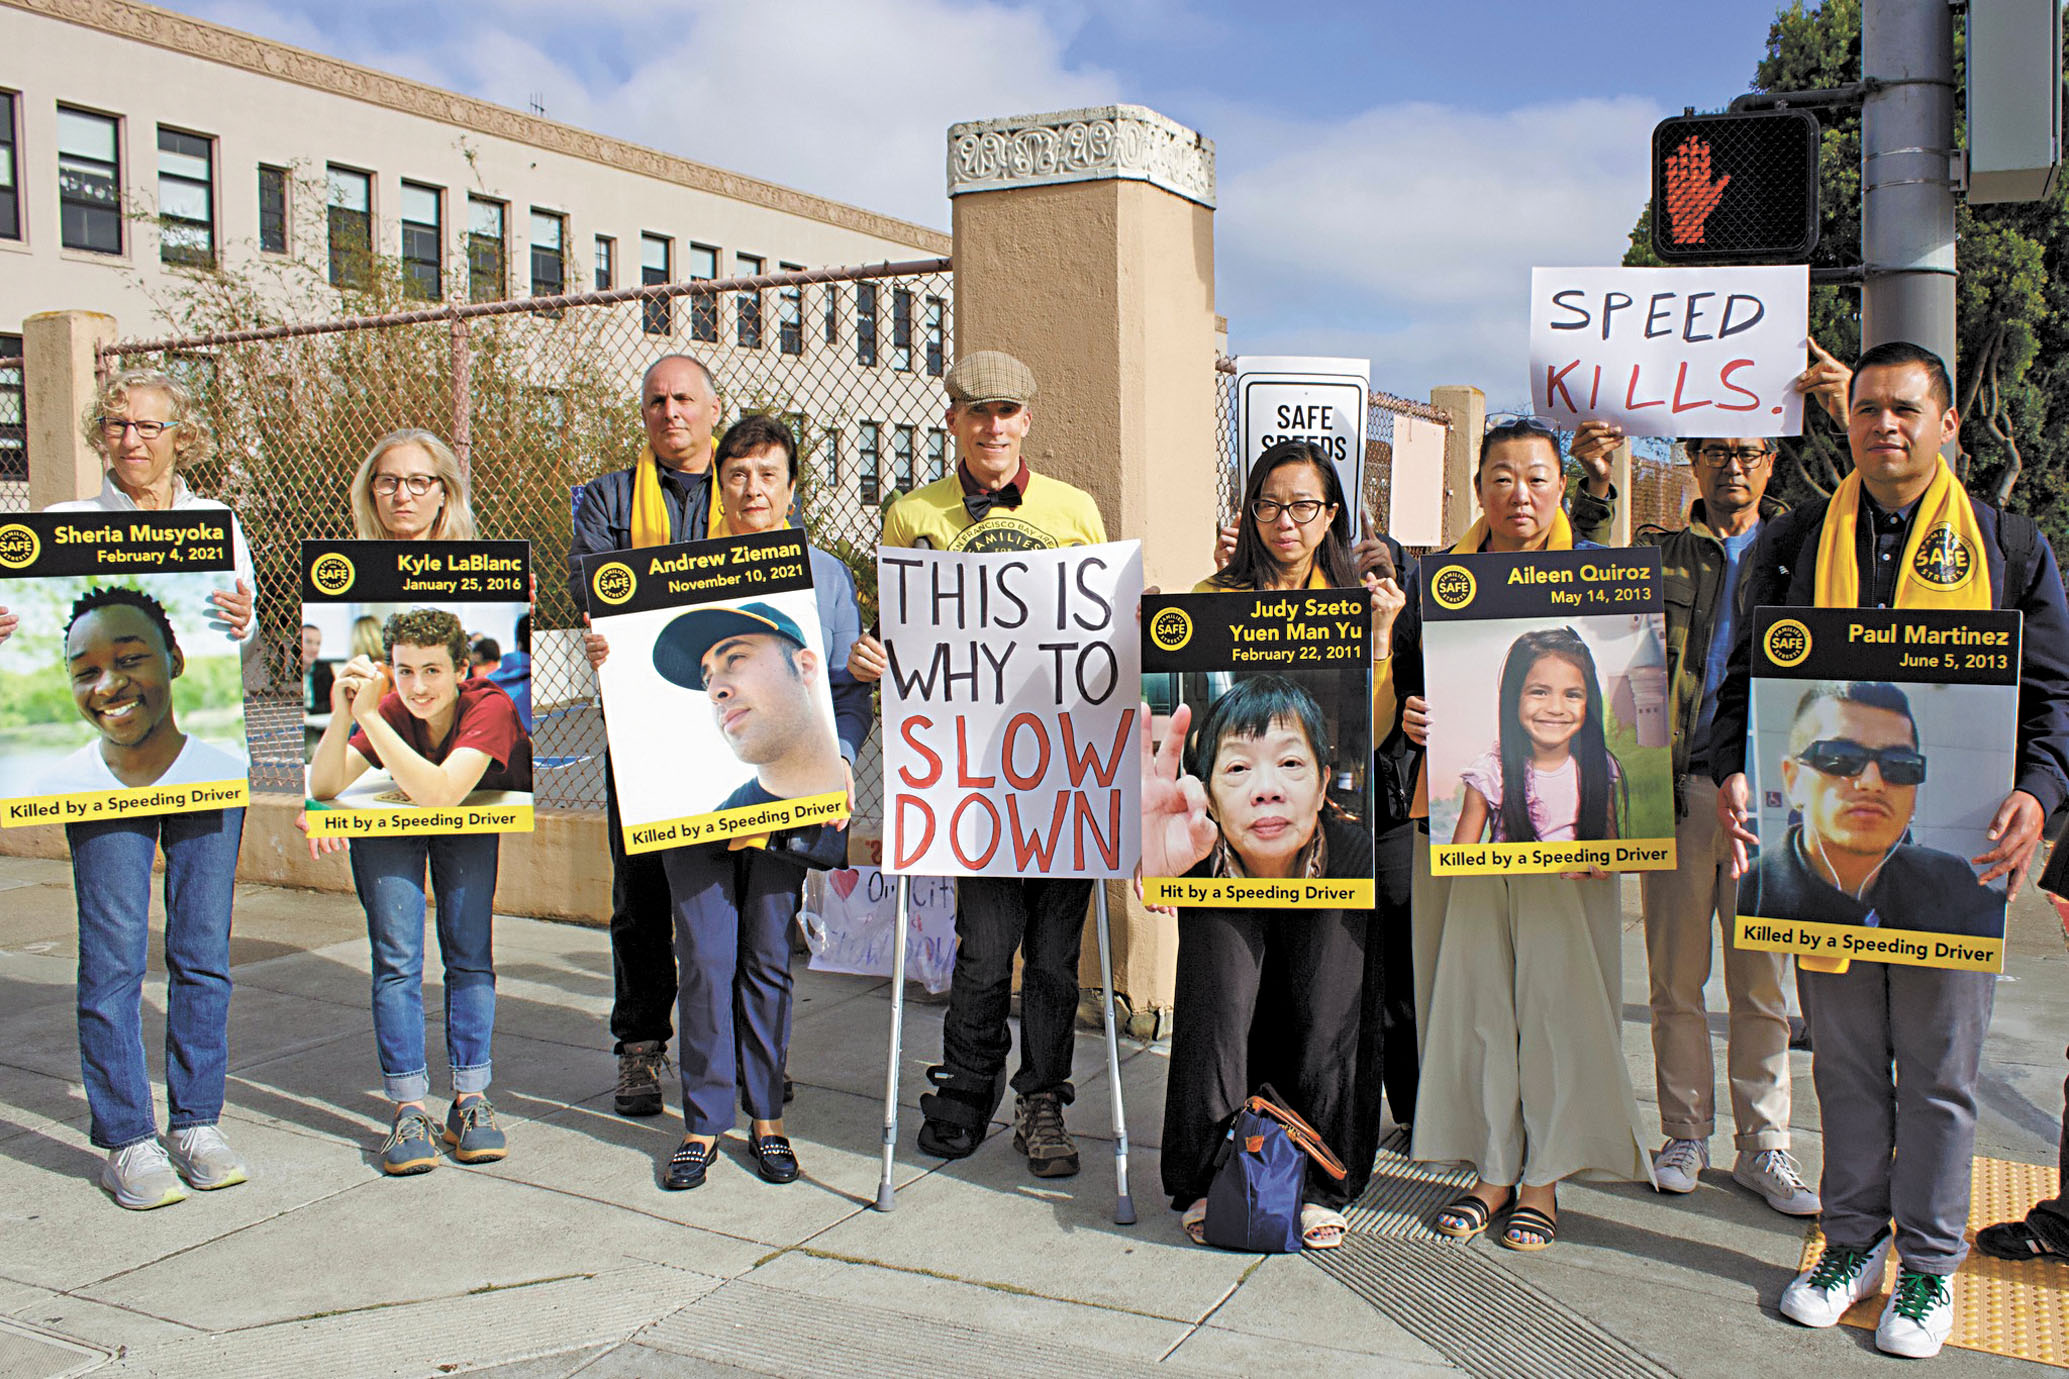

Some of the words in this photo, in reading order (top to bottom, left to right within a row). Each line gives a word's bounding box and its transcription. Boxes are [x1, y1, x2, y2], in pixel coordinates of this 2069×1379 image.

[1550, 289, 1765, 343] SPEED
[1547, 358, 1783, 414] KILLS.
[1277, 405, 1333, 430] SAFE
[54, 525, 123, 544] Sheria
[129, 522, 224, 546] Musyoka
[962, 520, 1015, 542] FRANCISCO
[1017, 523, 1037, 537] BAY
[1038, 534, 1056, 549] ARE
[0, 541, 32, 552] SAFE
[97, 549, 165, 564] February
[169, 548, 184, 563] 4,
[188, 547, 224, 560] 2021
[398, 554, 441, 576] Kyle
[448, 554, 522, 571] LaBlanc
[648, 552, 726, 575] Andrew
[729, 543, 802, 565] Zieman
[318, 569, 348, 580] SAFE
[600, 577, 630, 590] SAFE
[668, 573, 742, 594] November
[744, 569, 766, 583] 10,
[770, 564, 803, 580] 2021
[1507, 565, 1574, 585] Aileen
[1579, 563, 1651, 581] Quiroz
[403, 578, 457, 593] January
[461, 578, 482, 592] 25,
[486, 578, 522, 590] 2016
[882, 557, 1029, 630] THIS
[1056, 557, 1113, 632] IS
[1439, 581, 1469, 593] SAFE
[1551, 590, 1582, 606] May
[1586, 589, 1610, 604] 14,
[1614, 587, 1652, 601] 2013
[1250, 599, 1299, 621] Judy
[1305, 598, 1362, 617] Szeto
[1157, 623, 1185, 635] SAFE
[1229, 624, 1279, 642] Yuen
[1286, 623, 1330, 641] Man
[1335, 622, 1362, 639] Yu
[1848, 623, 1897, 643] Paul
[1904, 625, 2009, 646] Martinez
[1232, 647, 1295, 663] February
[1299, 647, 1321, 661] 22,
[1326, 645, 1361, 659] 2011
[1771, 637, 1804, 649] SAFE
[884, 639, 1018, 705] WHY
[1038, 641, 1118, 706] TO
[1899, 653, 1939, 668] June
[1943, 653, 1959, 670] 5,
[1965, 654, 2008, 669] 2013
[897, 708, 1136, 791] SLOW
[10, 802, 60, 818] Killed
[66, 800, 87, 816] by
[93, 802, 103, 811] a
[108, 793, 185, 812] Speeding
[191, 788, 241, 803] Driver
[325, 816, 348, 829] Hit
[353, 815, 372, 831] by
[378, 819, 387, 828] a
[391, 813, 463, 830] Speeding
[469, 812, 516, 825] Driver
[632, 826, 676, 845] Killed
[681, 824, 700, 839] by
[705, 824, 715, 833] a
[719, 810, 790, 832] Speeding
[794, 801, 841, 819] Driver
[893, 789, 1122, 873] DOWN
[1439, 852, 1485, 866] Killed
[1492, 851, 1512, 868] by
[1518, 854, 1527, 864] a
[1532, 848, 1610, 867] Speeding
[1616, 847, 1668, 861] Driver
[1160, 885, 1183, 898] Hit
[1188, 885, 1207, 902] by
[1212, 889, 1221, 898] a
[1226, 885, 1300, 903] Speeding
[1305, 886, 1355, 899] Driver
[1744, 925, 1793, 943] Killed
[1799, 929, 1821, 949] by
[1826, 937, 1837, 947] a
[1843, 934, 1928, 959] Speeding
[1935, 943, 1994, 962] Driver
